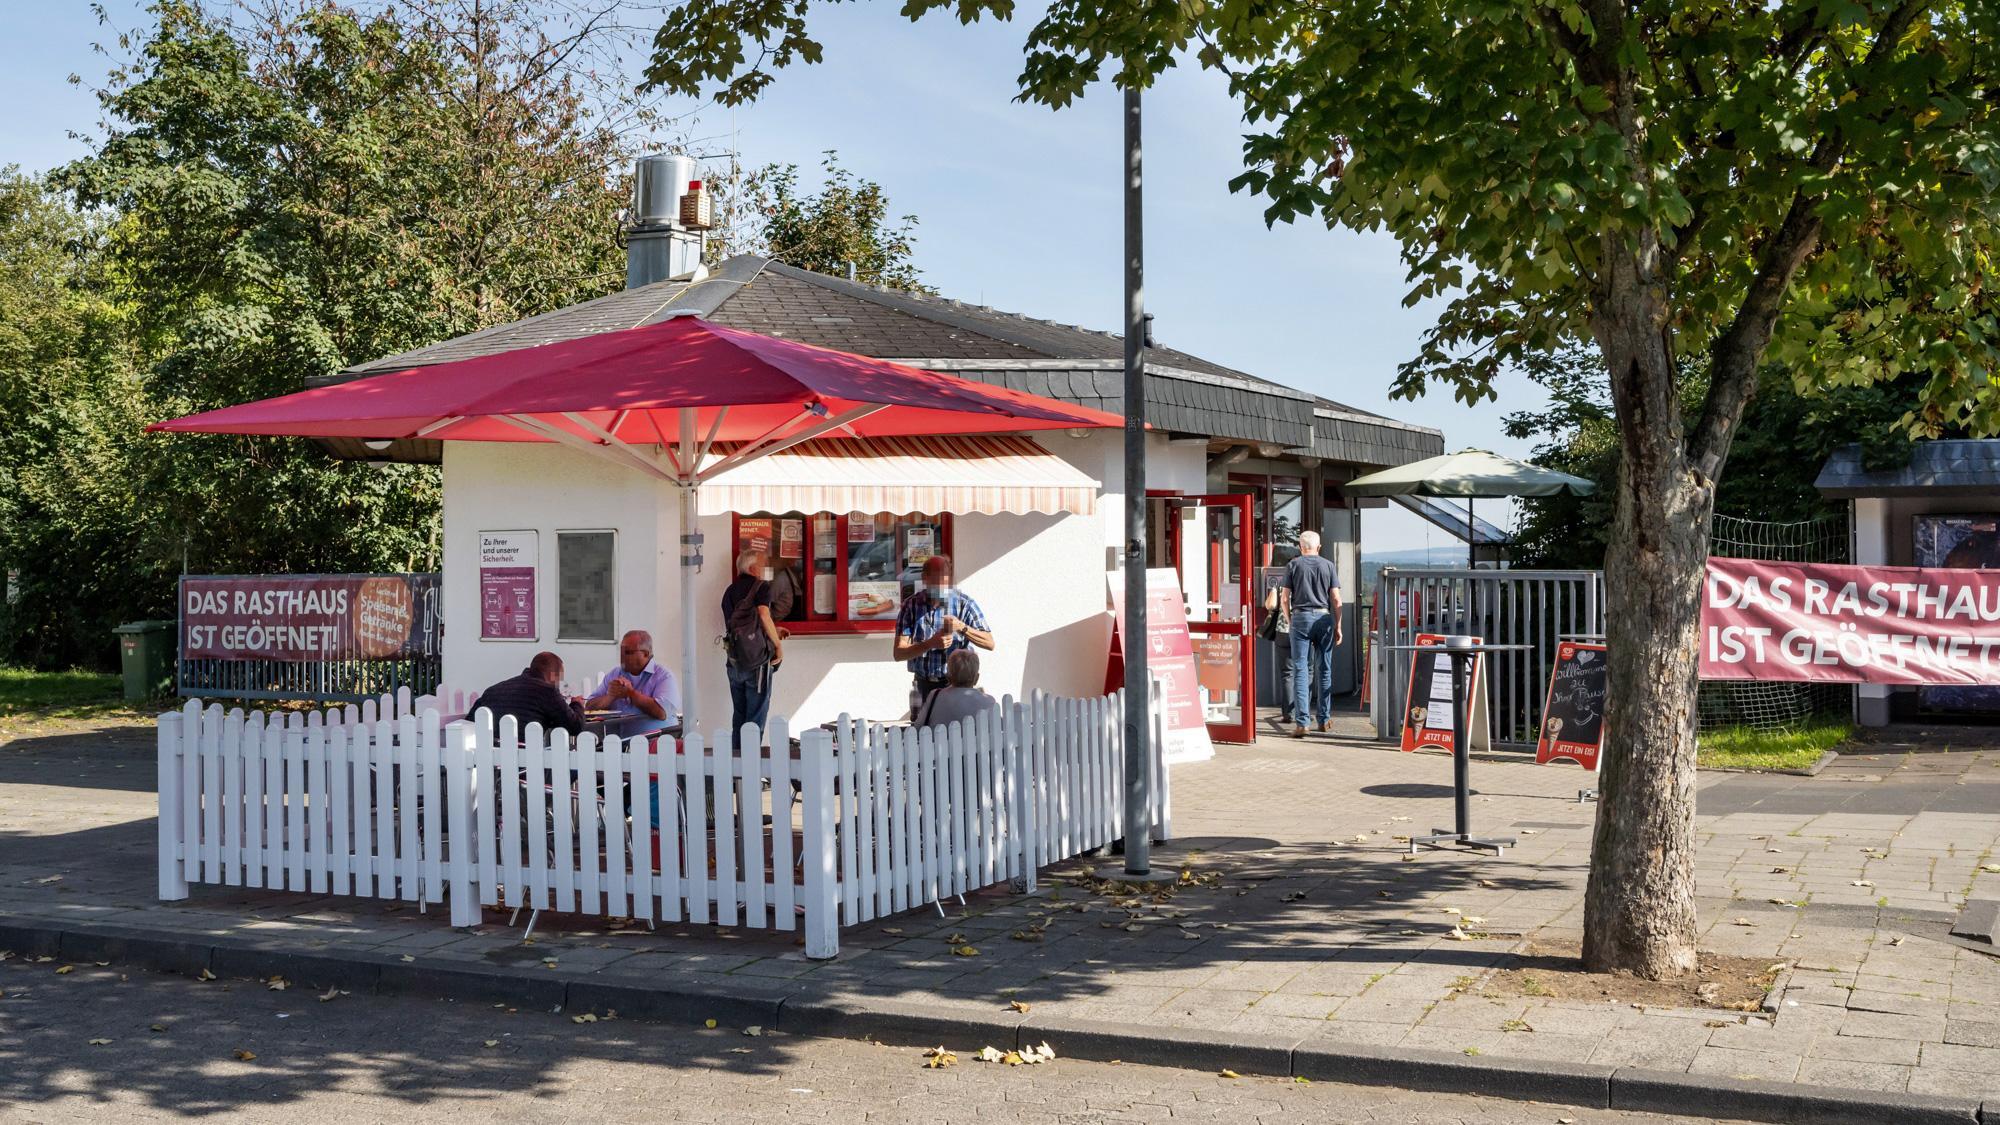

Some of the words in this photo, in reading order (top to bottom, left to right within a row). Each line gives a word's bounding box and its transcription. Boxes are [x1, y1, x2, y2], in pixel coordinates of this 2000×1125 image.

[483, 538, 492, 546] Zu
[493, 538, 508, 546] Ihrer
[187, 590, 229, 615] DAS
[233, 588, 348, 616] RASTHAUS
[1708, 571, 1792, 613] DAS
[361, 595, 398, 615] Speisen
[360, 611, 403, 633] Getränke
[187, 624, 217, 649] IST
[221, 618, 337, 650] GEÖFFNET!
[1708, 625, 1771, 664] IST
[1780, 622, 2000, 672] GEÖFFNET
[1571, 680, 1586, 688] zu
[1423, 733, 1441, 742] JETZT
[1441, 734, 1452, 742] EIN
[1557, 744, 1573, 754] JETZT
[1573, 746, 1584, 755] EIN
